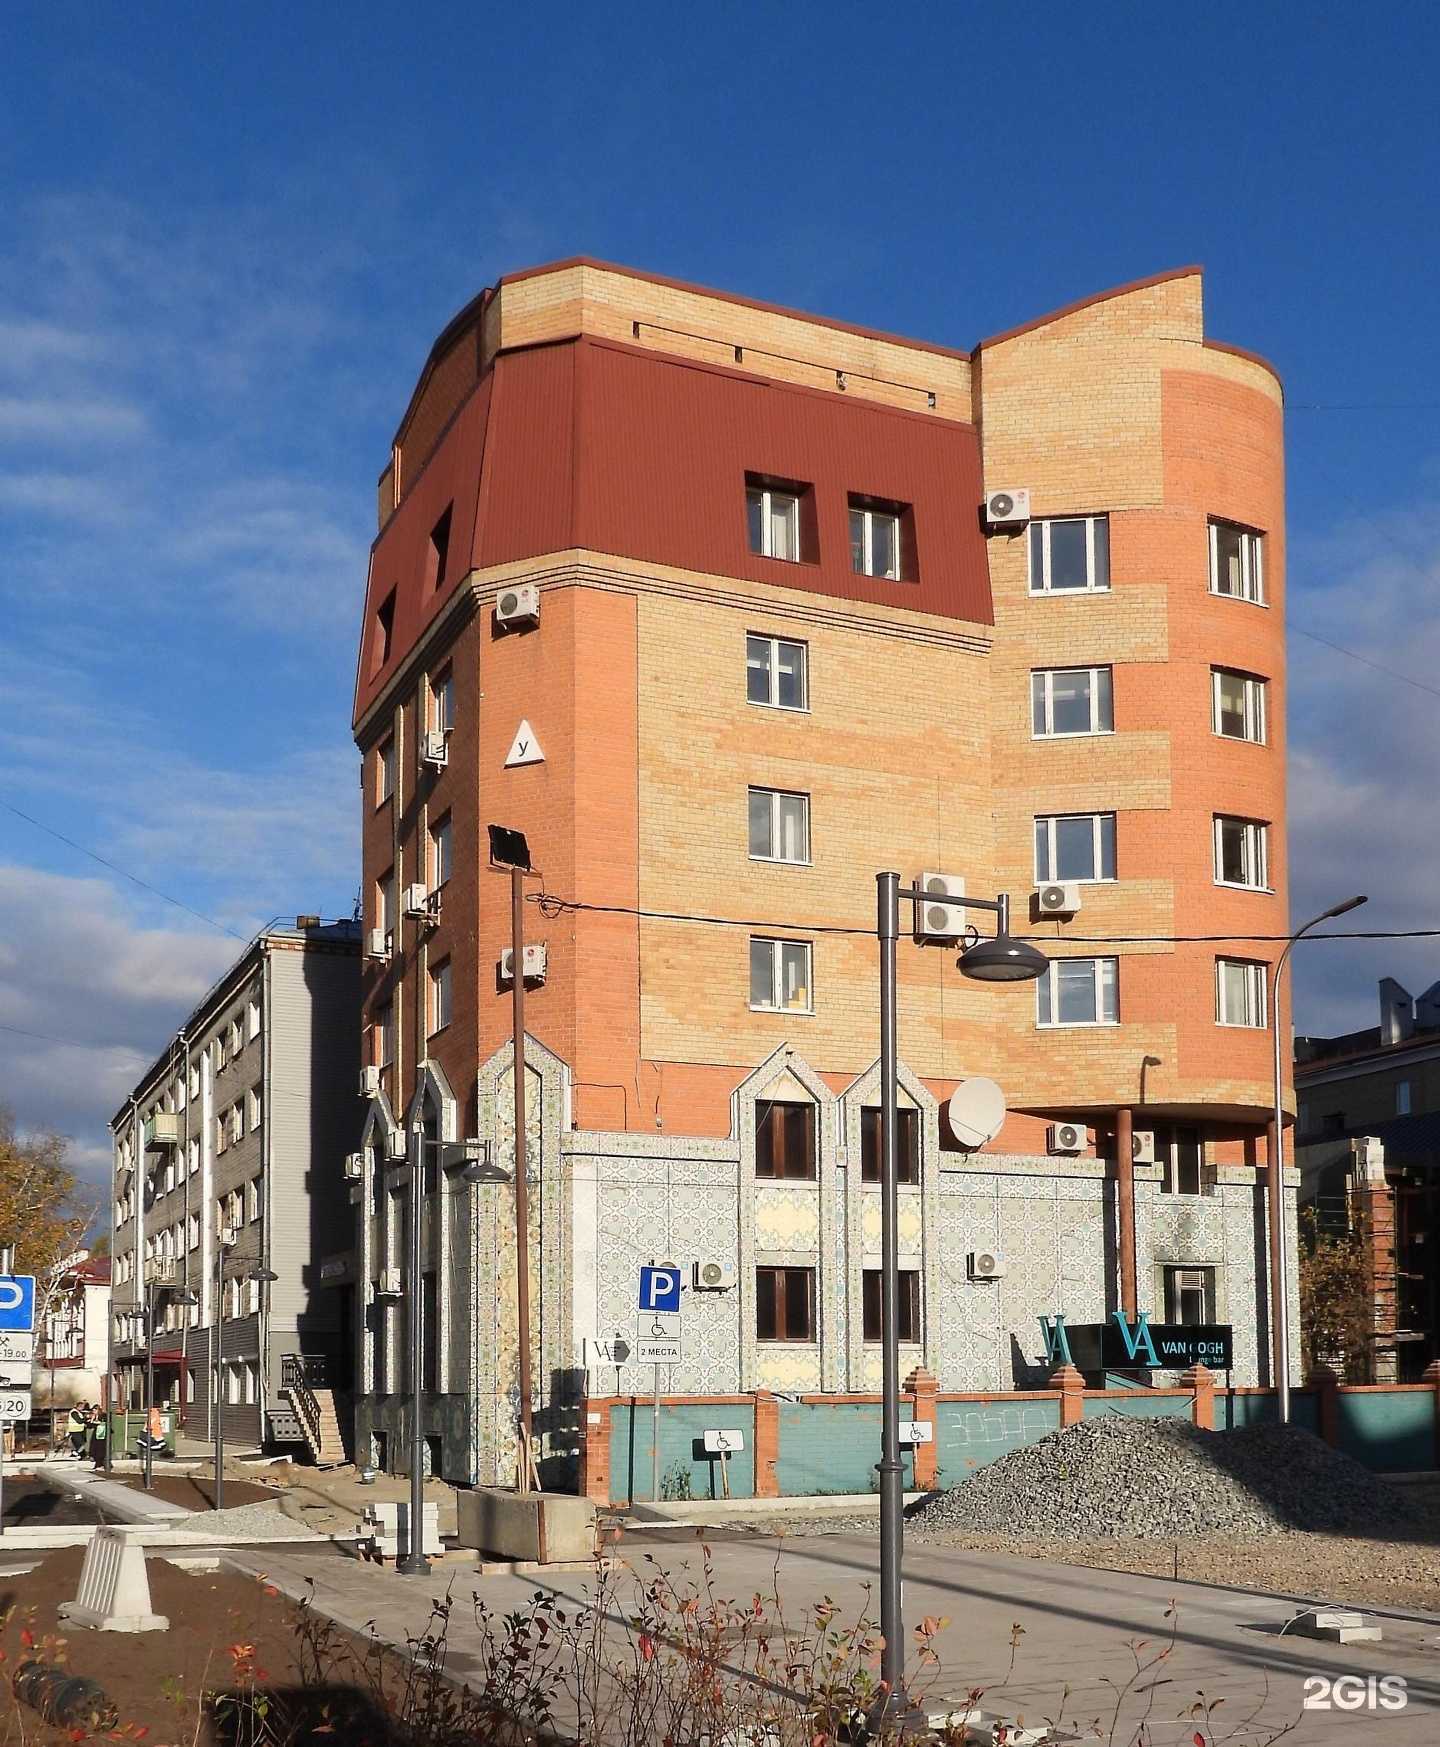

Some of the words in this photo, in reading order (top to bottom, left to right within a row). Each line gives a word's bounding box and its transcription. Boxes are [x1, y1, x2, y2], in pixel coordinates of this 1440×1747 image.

[650, 1271, 674, 1307] P
[641, 1348, 646, 1356] 2
[648, 1348, 678, 1356] МЕСТА
[1161, 1341, 1187, 1354] VAN
[7, 1400, 24, 1412] 20
